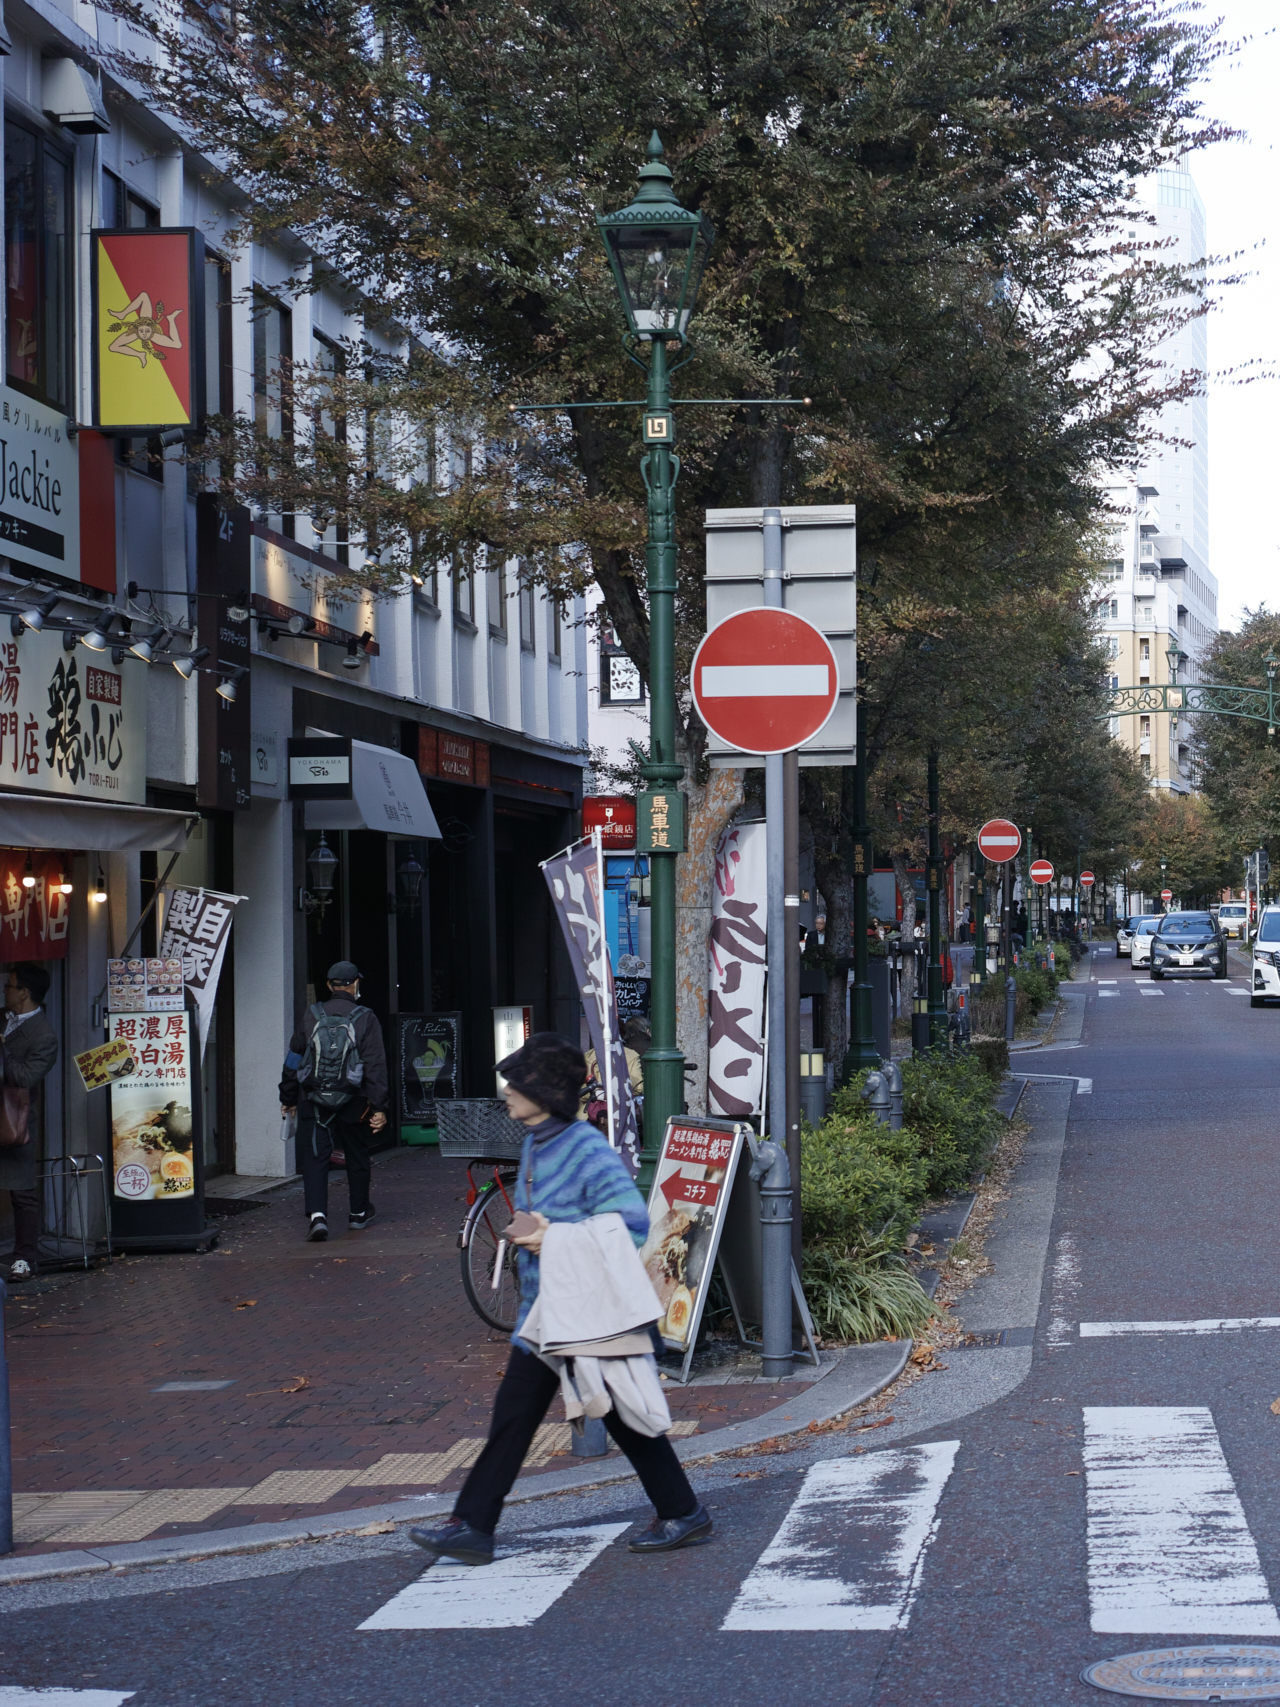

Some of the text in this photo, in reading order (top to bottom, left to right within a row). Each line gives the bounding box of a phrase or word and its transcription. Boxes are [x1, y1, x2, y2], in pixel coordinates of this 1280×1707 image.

[0, 439, 61, 516] Jackie
[88, 671, 119, 702] 自家製麺
[89, 773, 119, 789] TORI-FUJI
[309, 766, 330, 777] Bis
[584, 825, 634, 834] 山眼鏡店
[650, 795, 671, 848] 馬車道
[854, 844, 866, 873] 馬車道
[183, 902, 231, 982] 自家
[615, 989, 640, 999] カレーと
[114, 1015, 187, 1041] 超濃厚
[503, 1011, 515, 1057] 山下眼
[80, 1042, 128, 1075] ランチタイム
[668, 1143, 708, 1160] ラーメン専門店
[120, 1177, 145, 1190] 一杯
[122, 1169, 145, 1178] 至極の
[683, 1184, 706, 1200] コチラ
